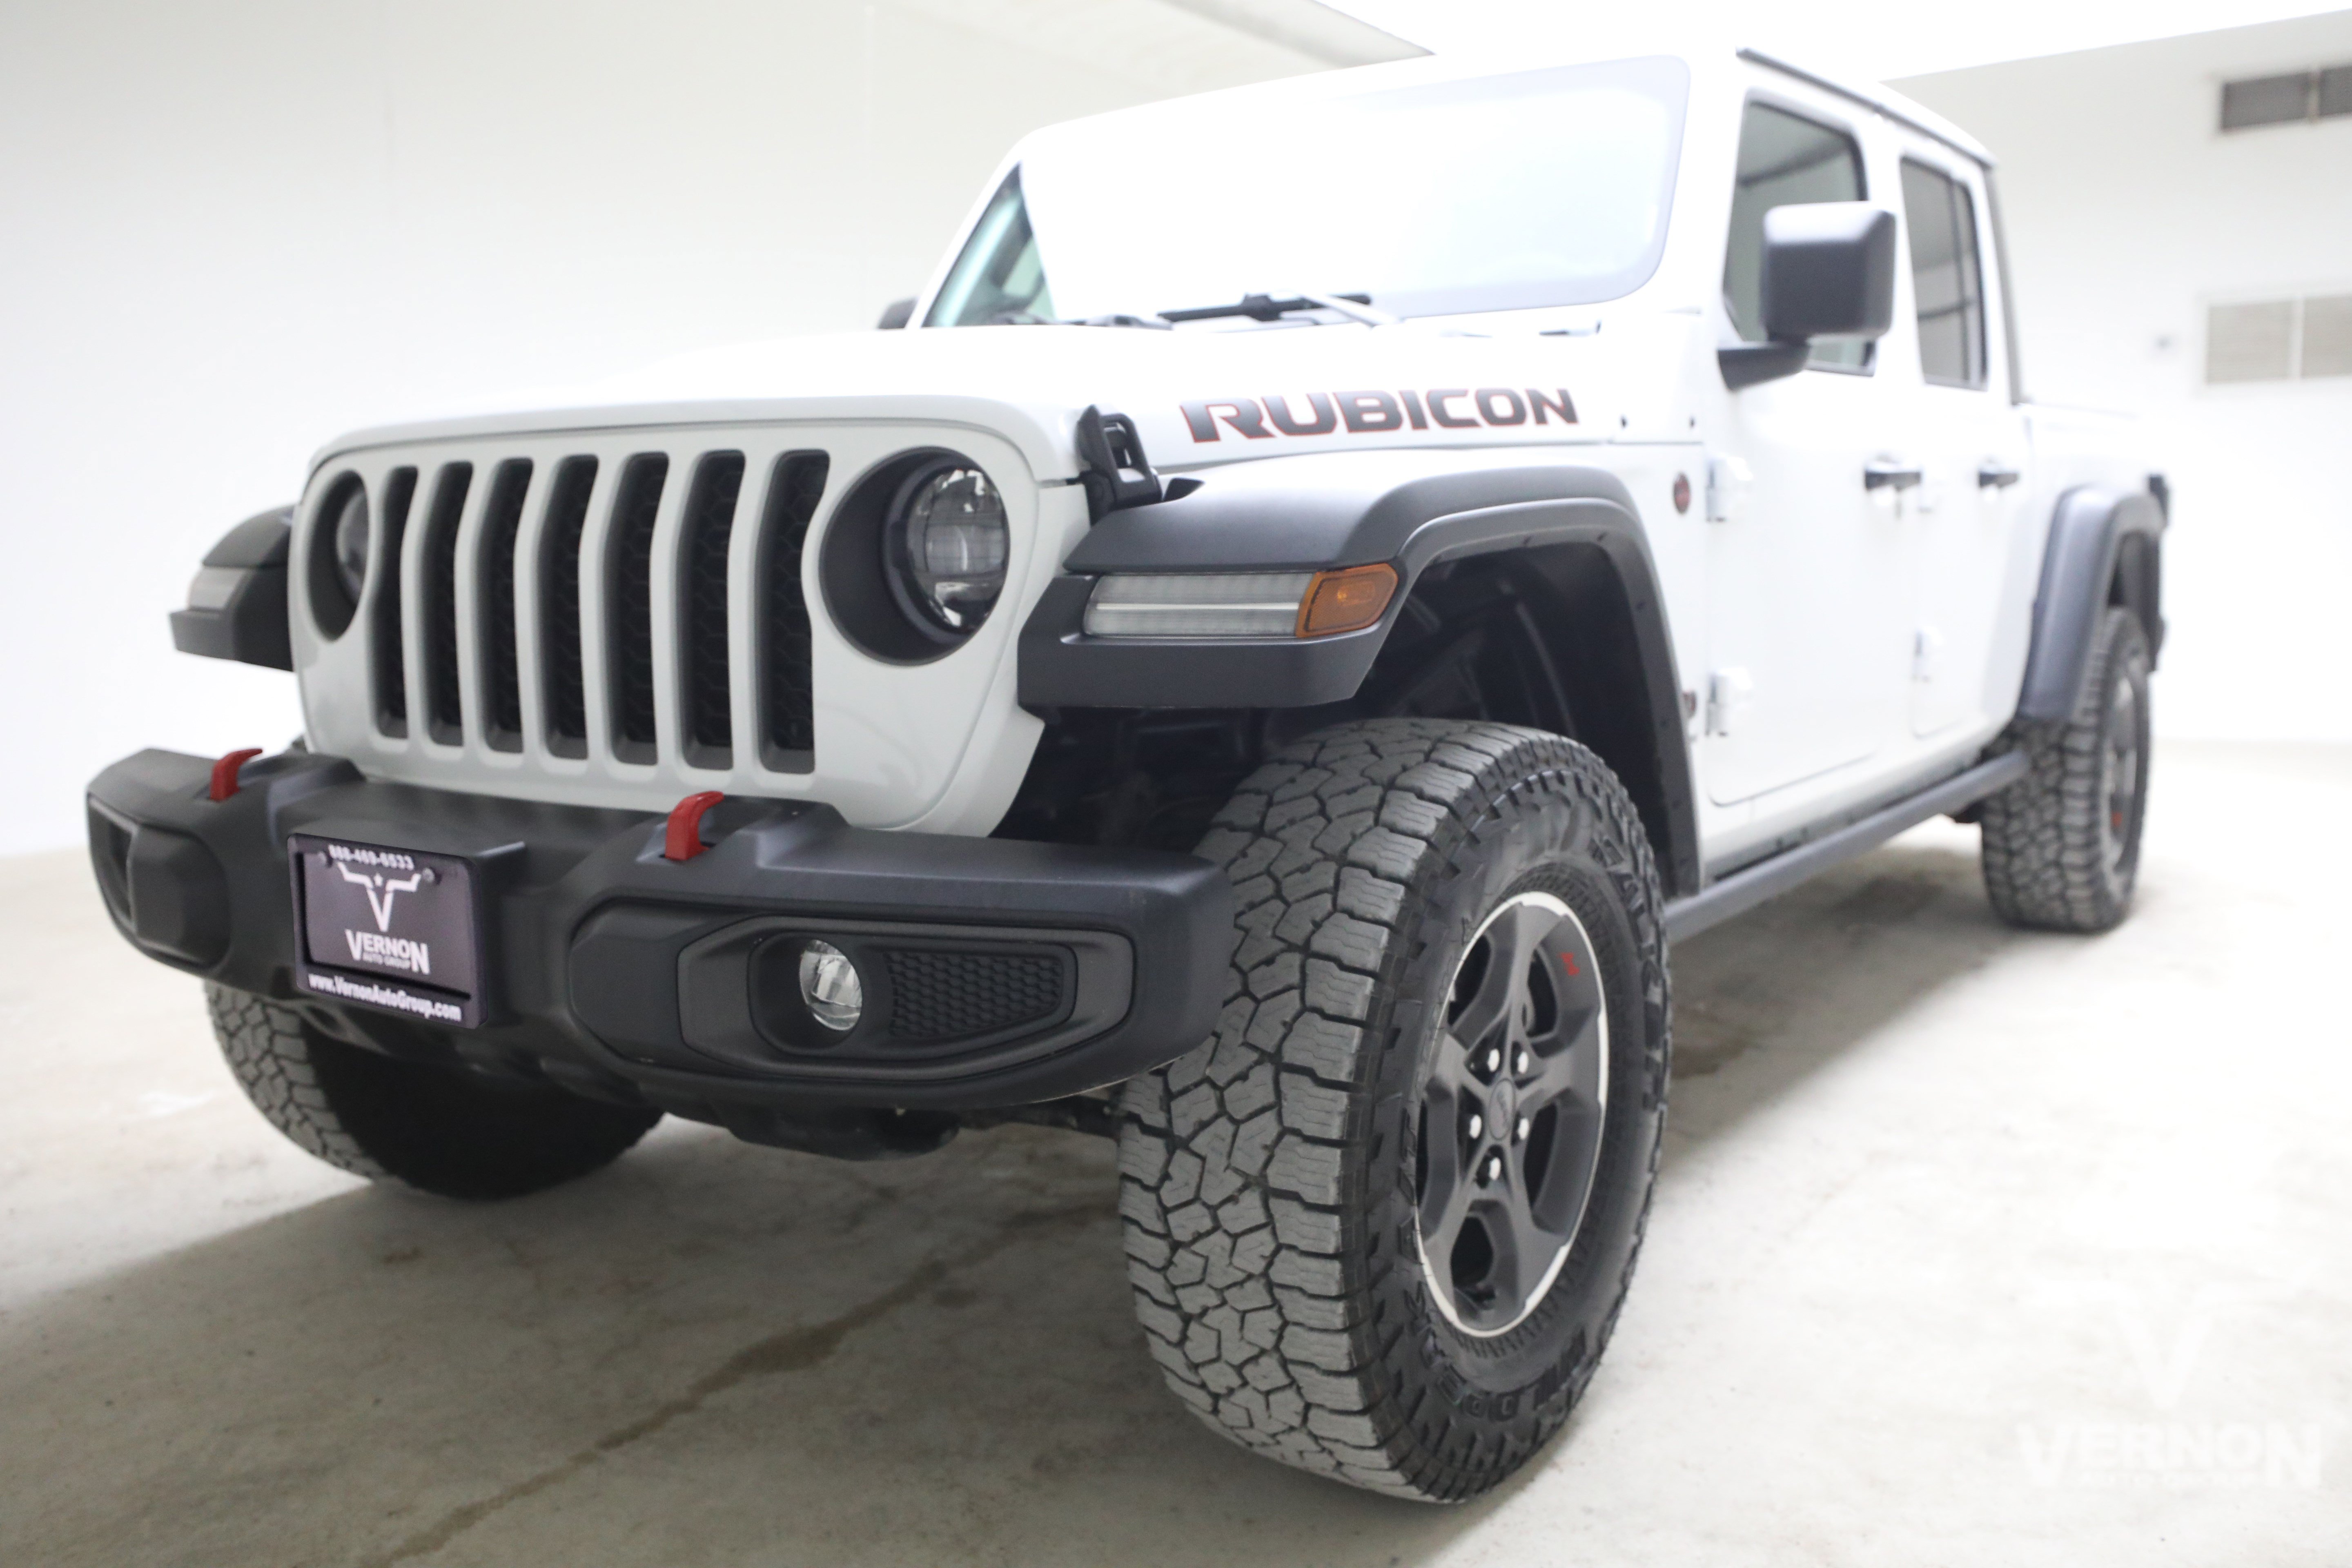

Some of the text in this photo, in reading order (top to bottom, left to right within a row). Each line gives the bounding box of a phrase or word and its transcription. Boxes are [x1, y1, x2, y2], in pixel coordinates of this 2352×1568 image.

[1179, 387, 1579, 443] RUBICON
[344, 928, 431, 976] VERNON
[308, 973, 463, 1022] www.VernonAutoGroup.com
